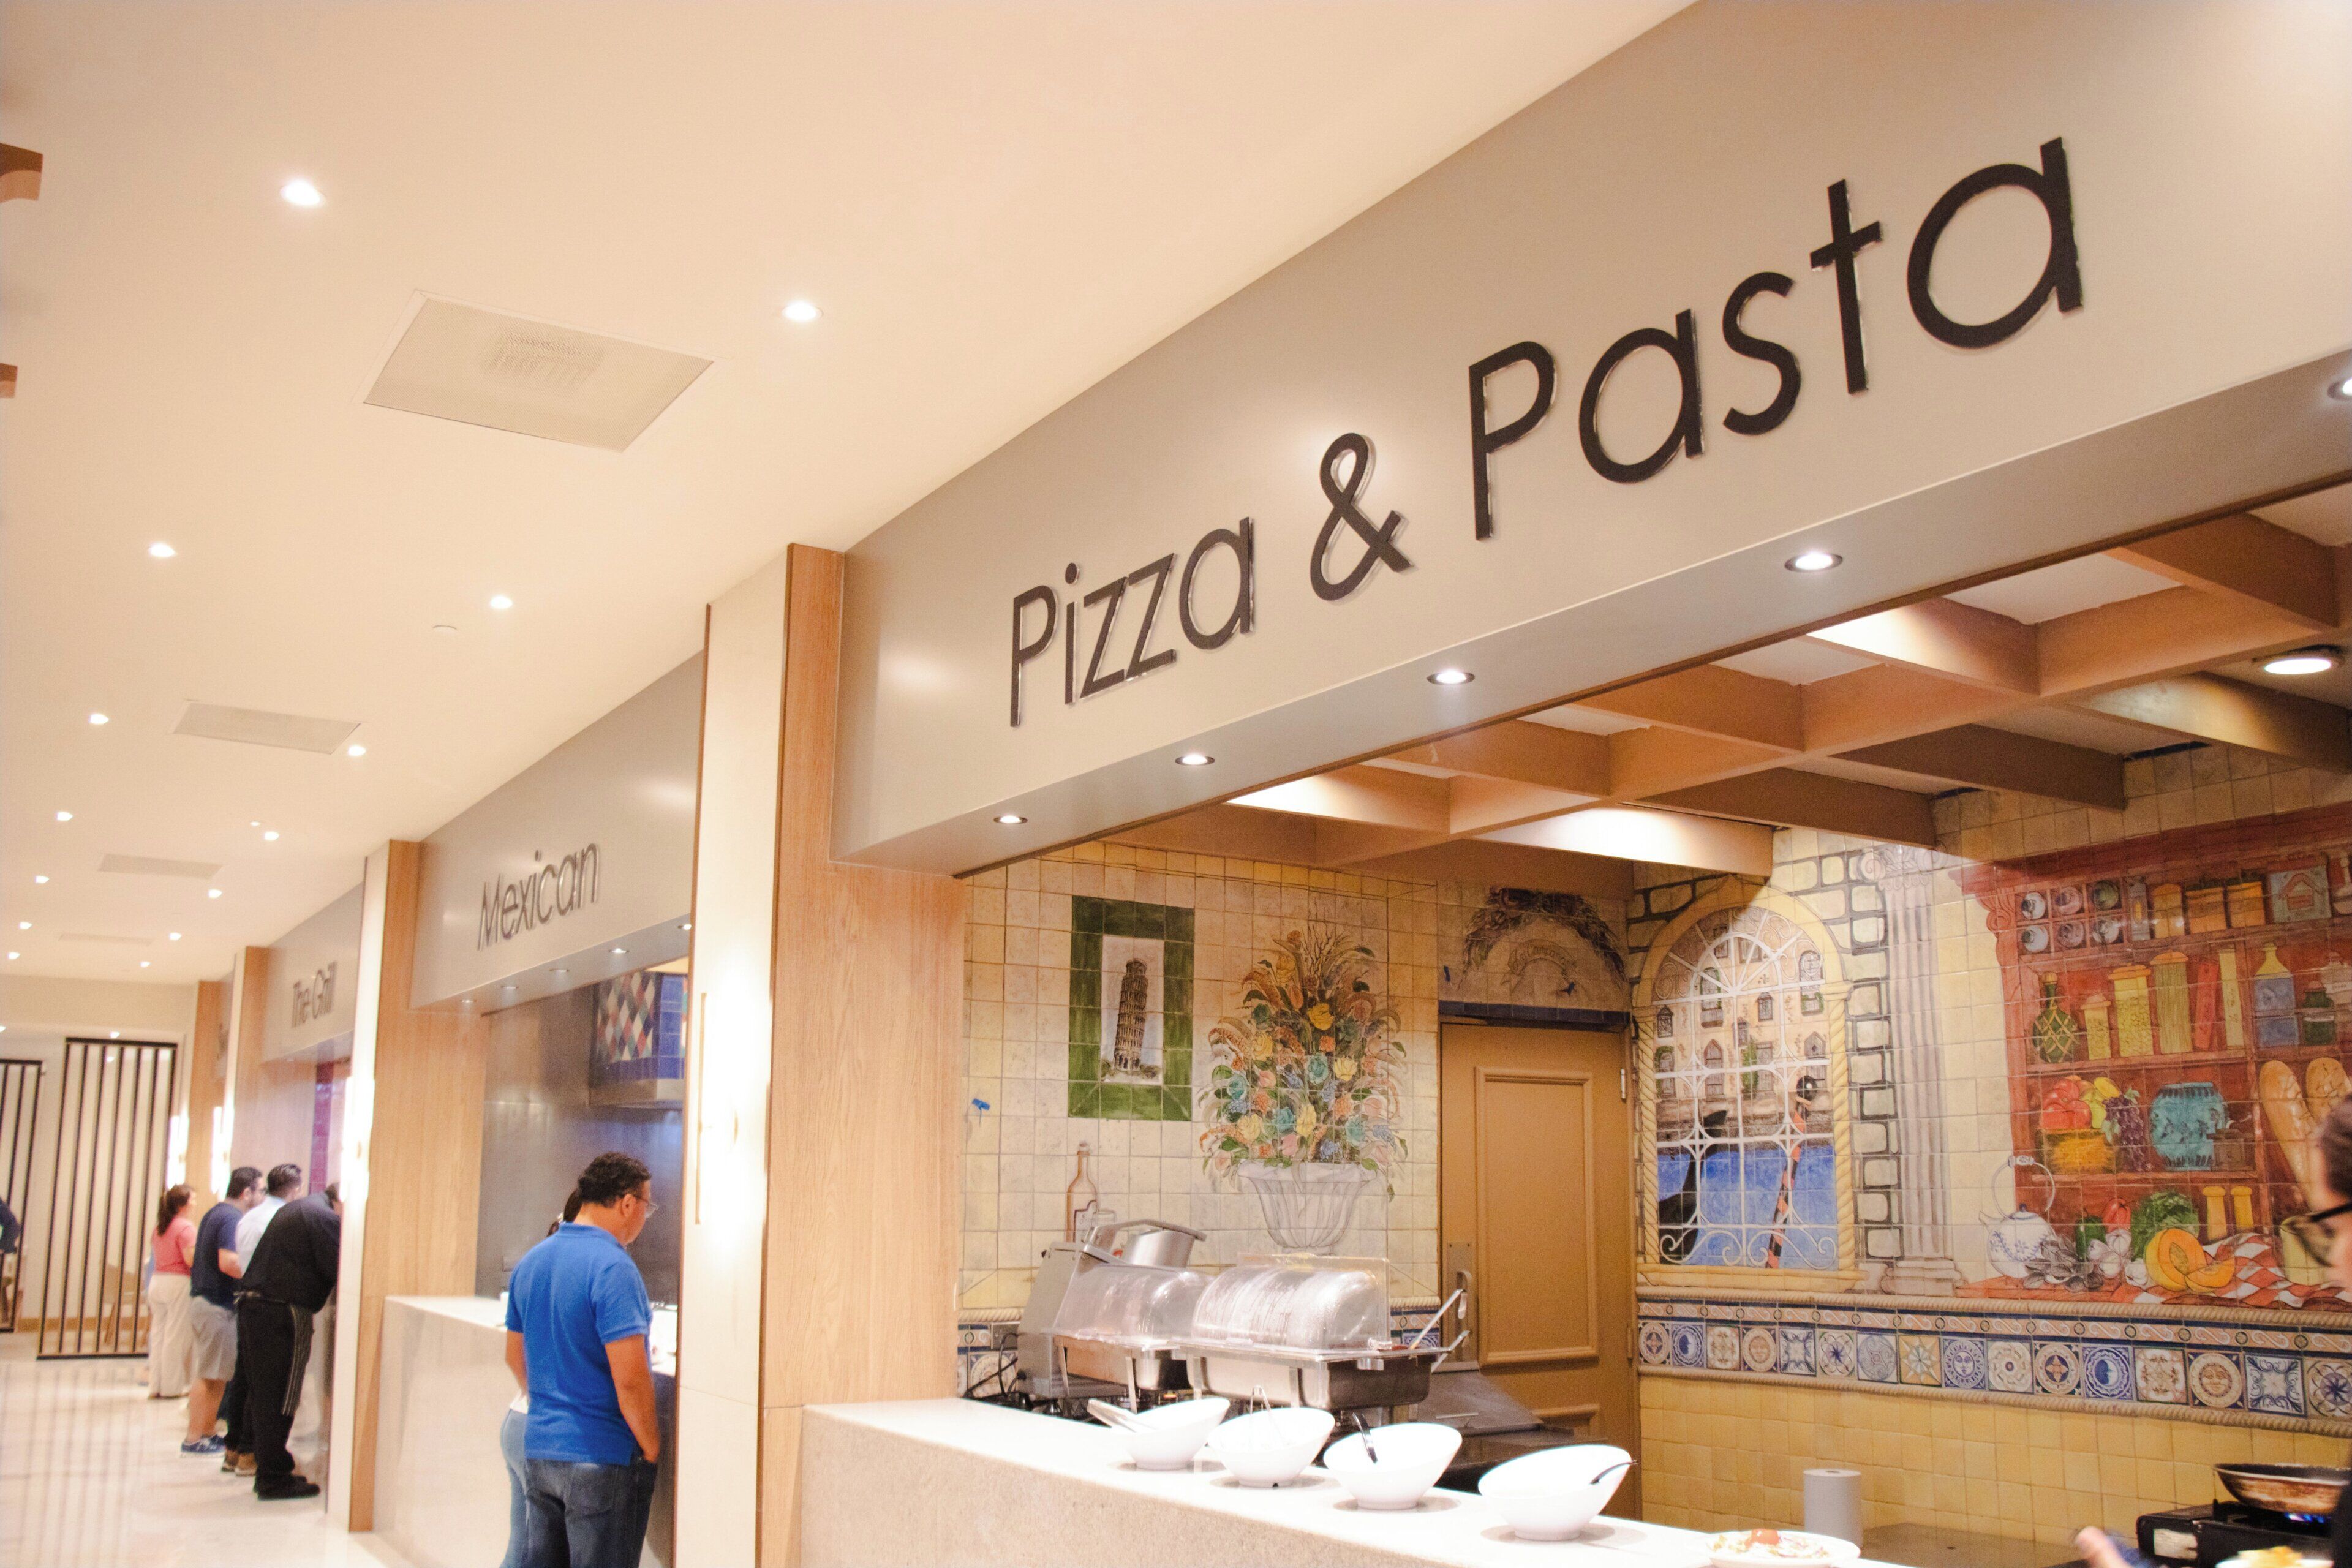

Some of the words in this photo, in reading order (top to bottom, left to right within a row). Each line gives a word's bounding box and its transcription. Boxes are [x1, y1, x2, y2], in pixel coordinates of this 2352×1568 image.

[1011, 516, 1254, 727] Pizza
[1310, 432, 1414, 600] &
[1469, 136, 2084, 541] Pasta
[477, 843, 598, 951] Mexican
[292, 981, 309, 1028] The
